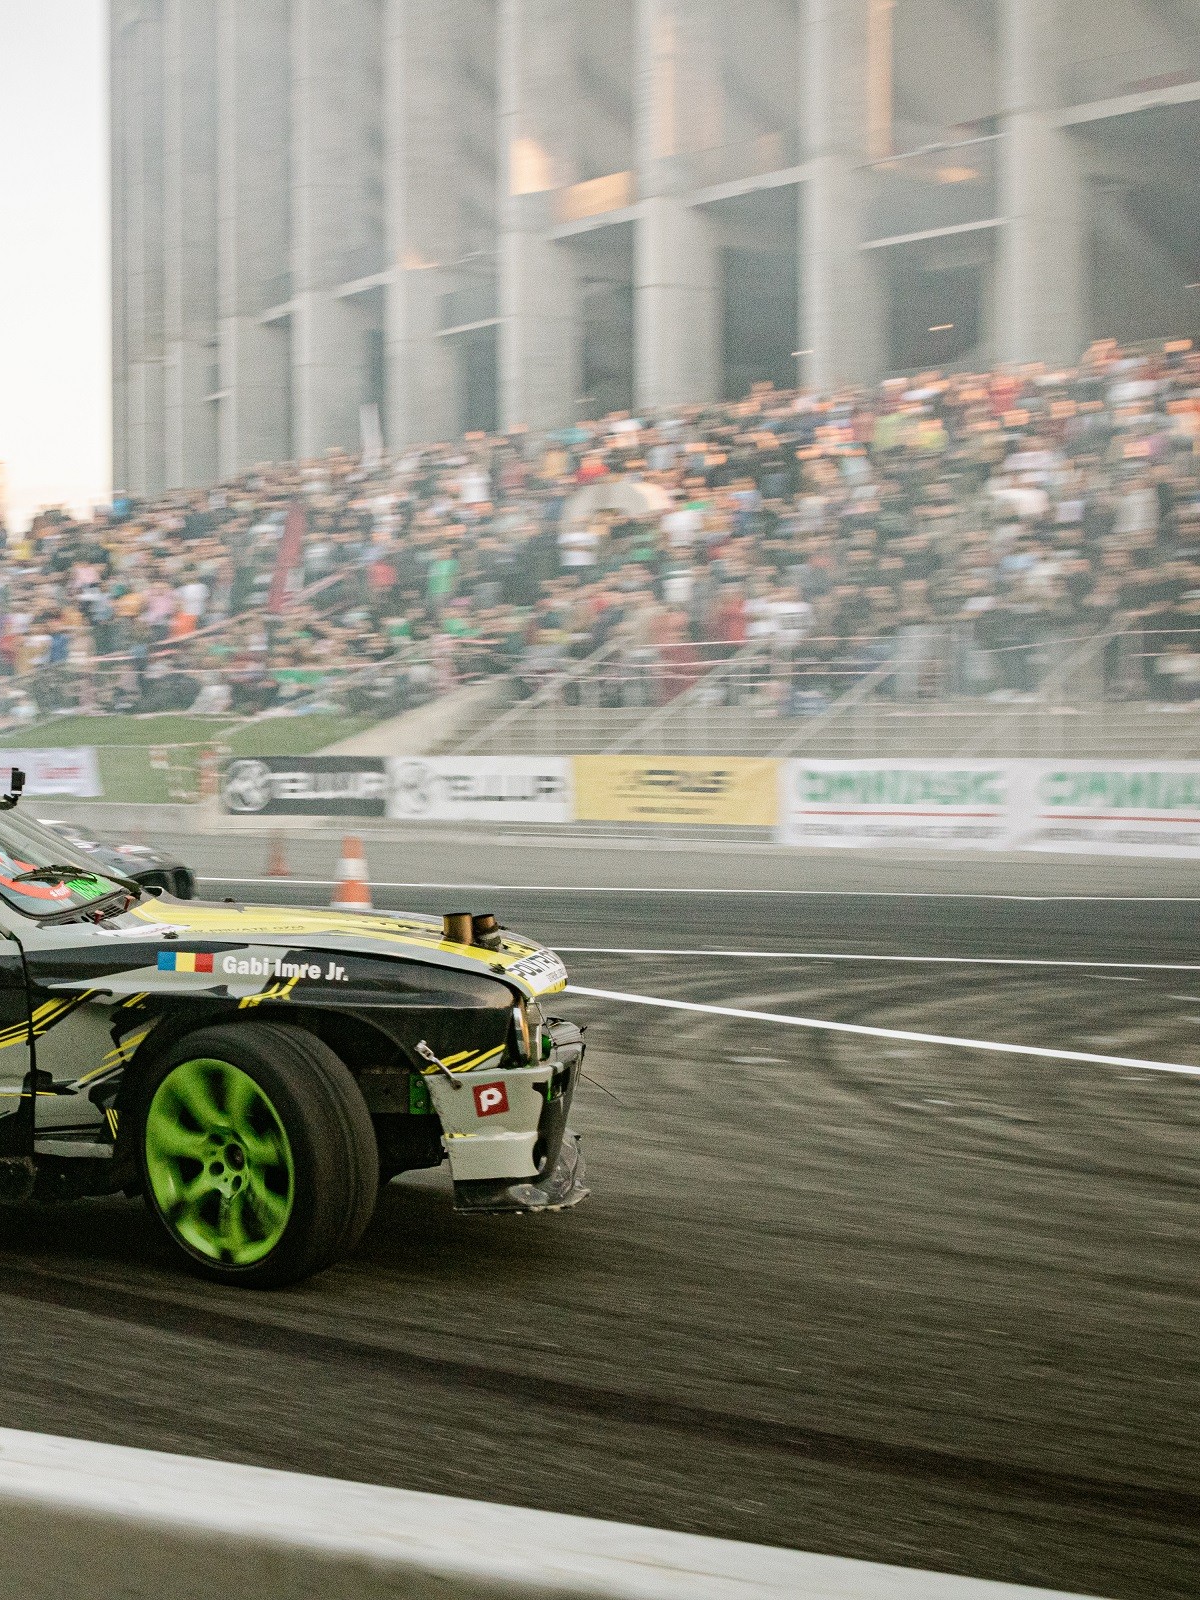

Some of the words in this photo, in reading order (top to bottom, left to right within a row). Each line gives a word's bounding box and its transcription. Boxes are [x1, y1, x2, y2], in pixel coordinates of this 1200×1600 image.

[222, 955, 270, 976] Gabi
[274, 957, 321, 980] Imre
[325, 961, 349, 982] Jr.
